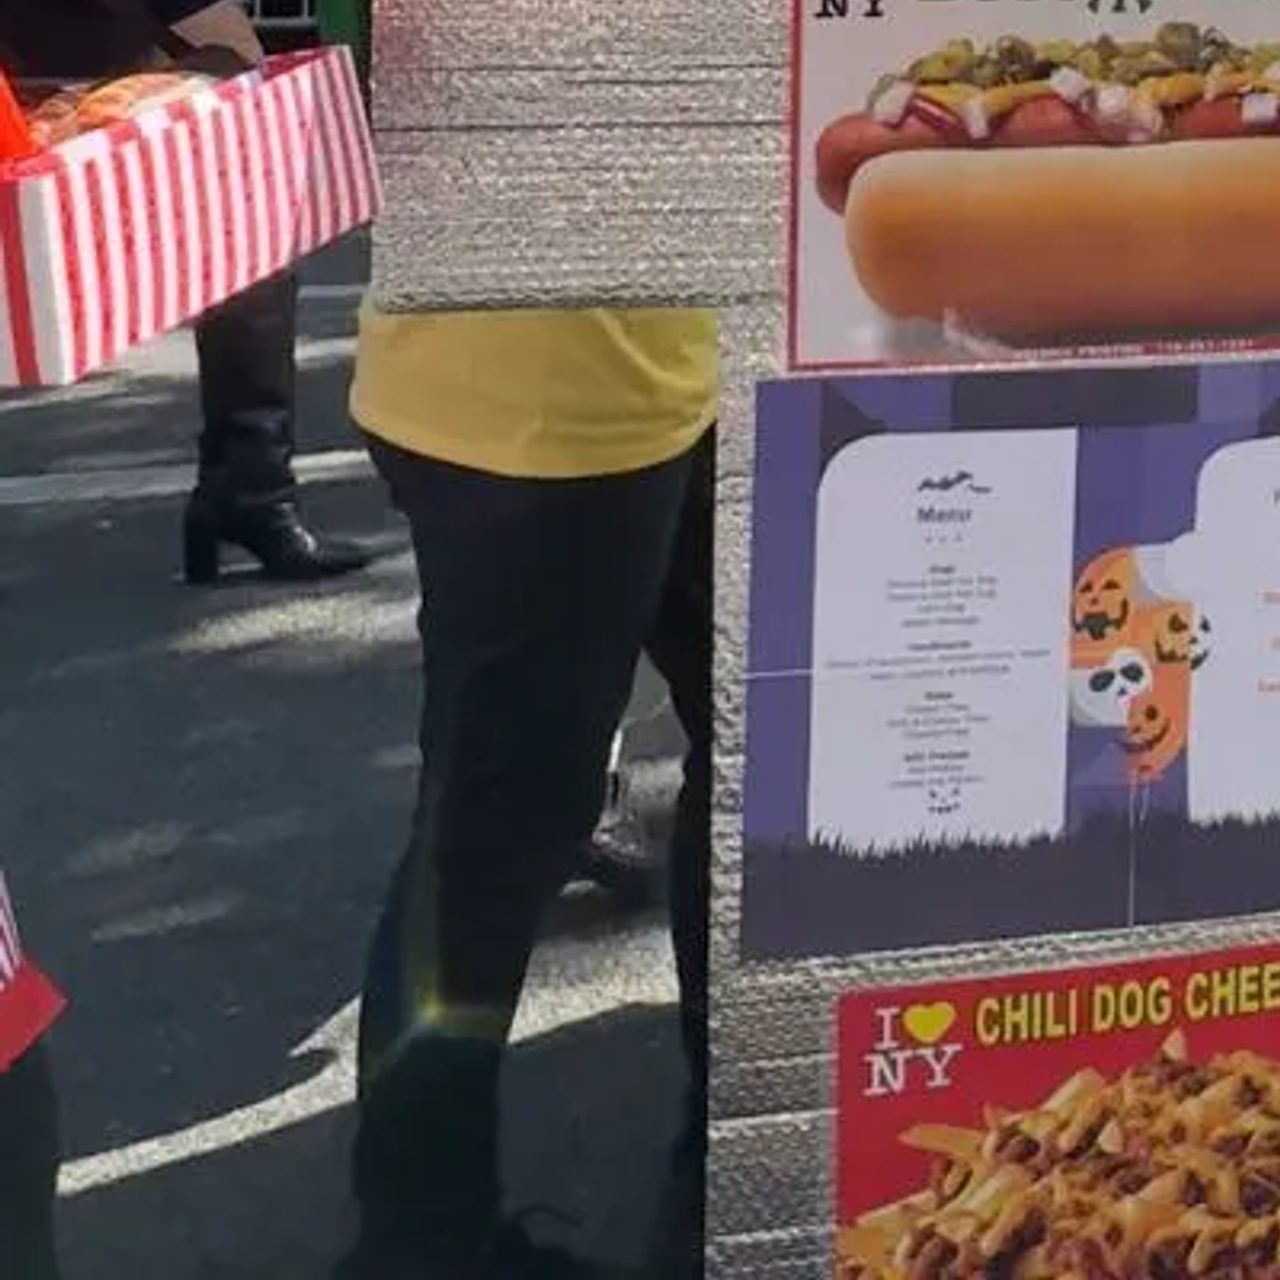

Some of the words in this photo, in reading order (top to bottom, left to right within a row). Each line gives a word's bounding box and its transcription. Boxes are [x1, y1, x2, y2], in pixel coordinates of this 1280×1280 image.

[917, 505, 974, 525] Menu
[975, 988, 1078, 1046] CHILI
[1091, 978, 1173, 1032] DOG
[863, 1042, 963, 1097] NY
